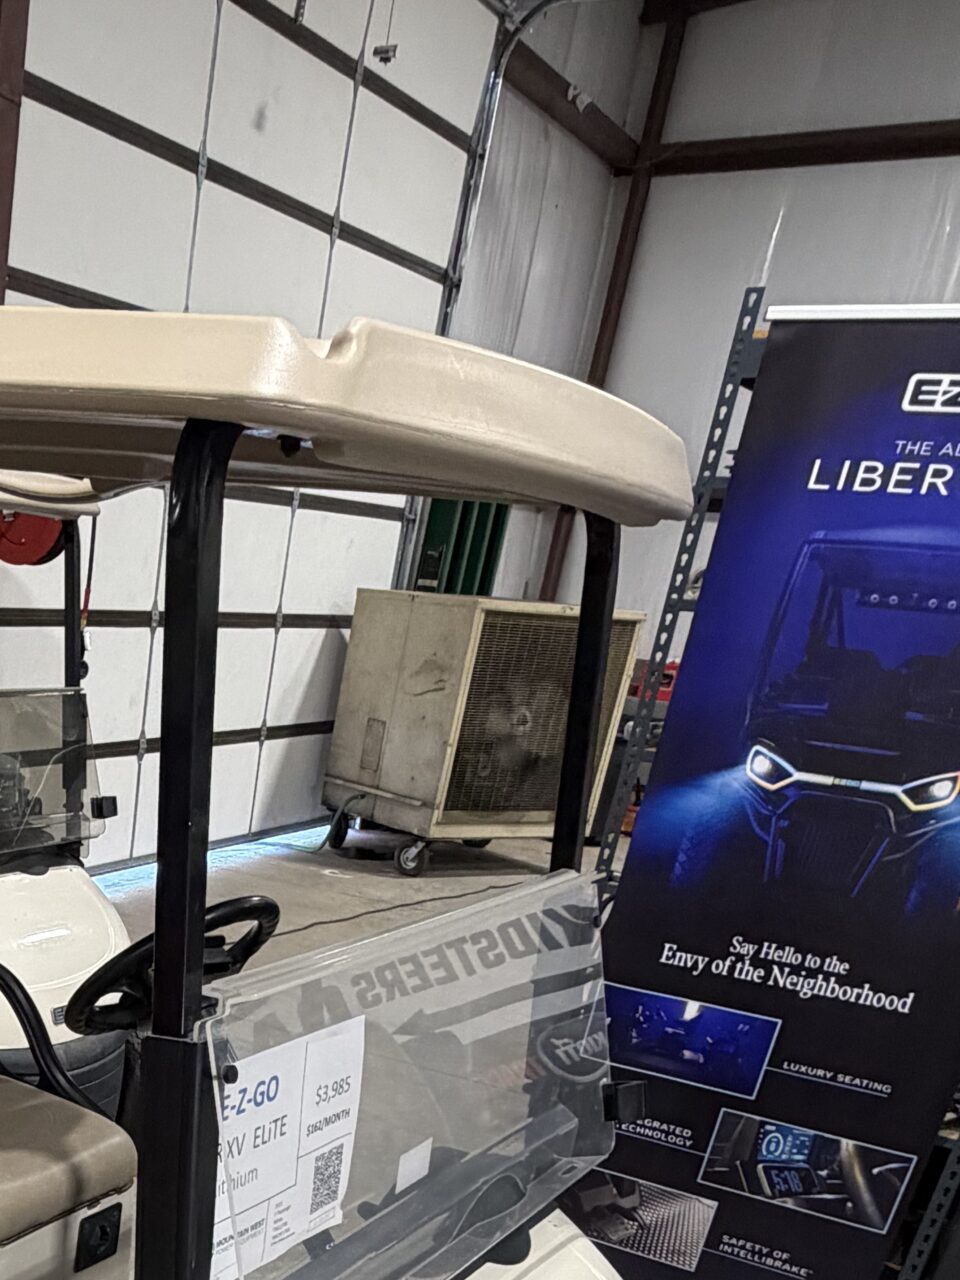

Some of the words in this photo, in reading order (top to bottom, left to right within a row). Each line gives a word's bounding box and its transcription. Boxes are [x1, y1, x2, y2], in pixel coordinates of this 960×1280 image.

[895, 440, 934, 456] THE
[729, 935, 758, 960] Say
[759, 941, 802, 965] Hello
[804, 952, 821, 969] to
[823, 954, 850, 975] the
[659, 942, 709, 976] Envy
[711, 955, 736, 976] of
[734, 959, 765, 983] the
[767, 965, 915, 1014] Neighborhood
[315, 1075, 351, 1106] $3,985
[782, 1060, 835, 1080] LUXURY
[836, 1073, 893, 1094] SEATING
[616, 1121, 694, 1147] ECHNOLOGY
[636, 1118, 692, 1138] GRATED
[218, 1168, 259, 1197] ithium
[721, 1234, 771, 1255] SAFETY
[772, 1249, 792, 1261] OF
